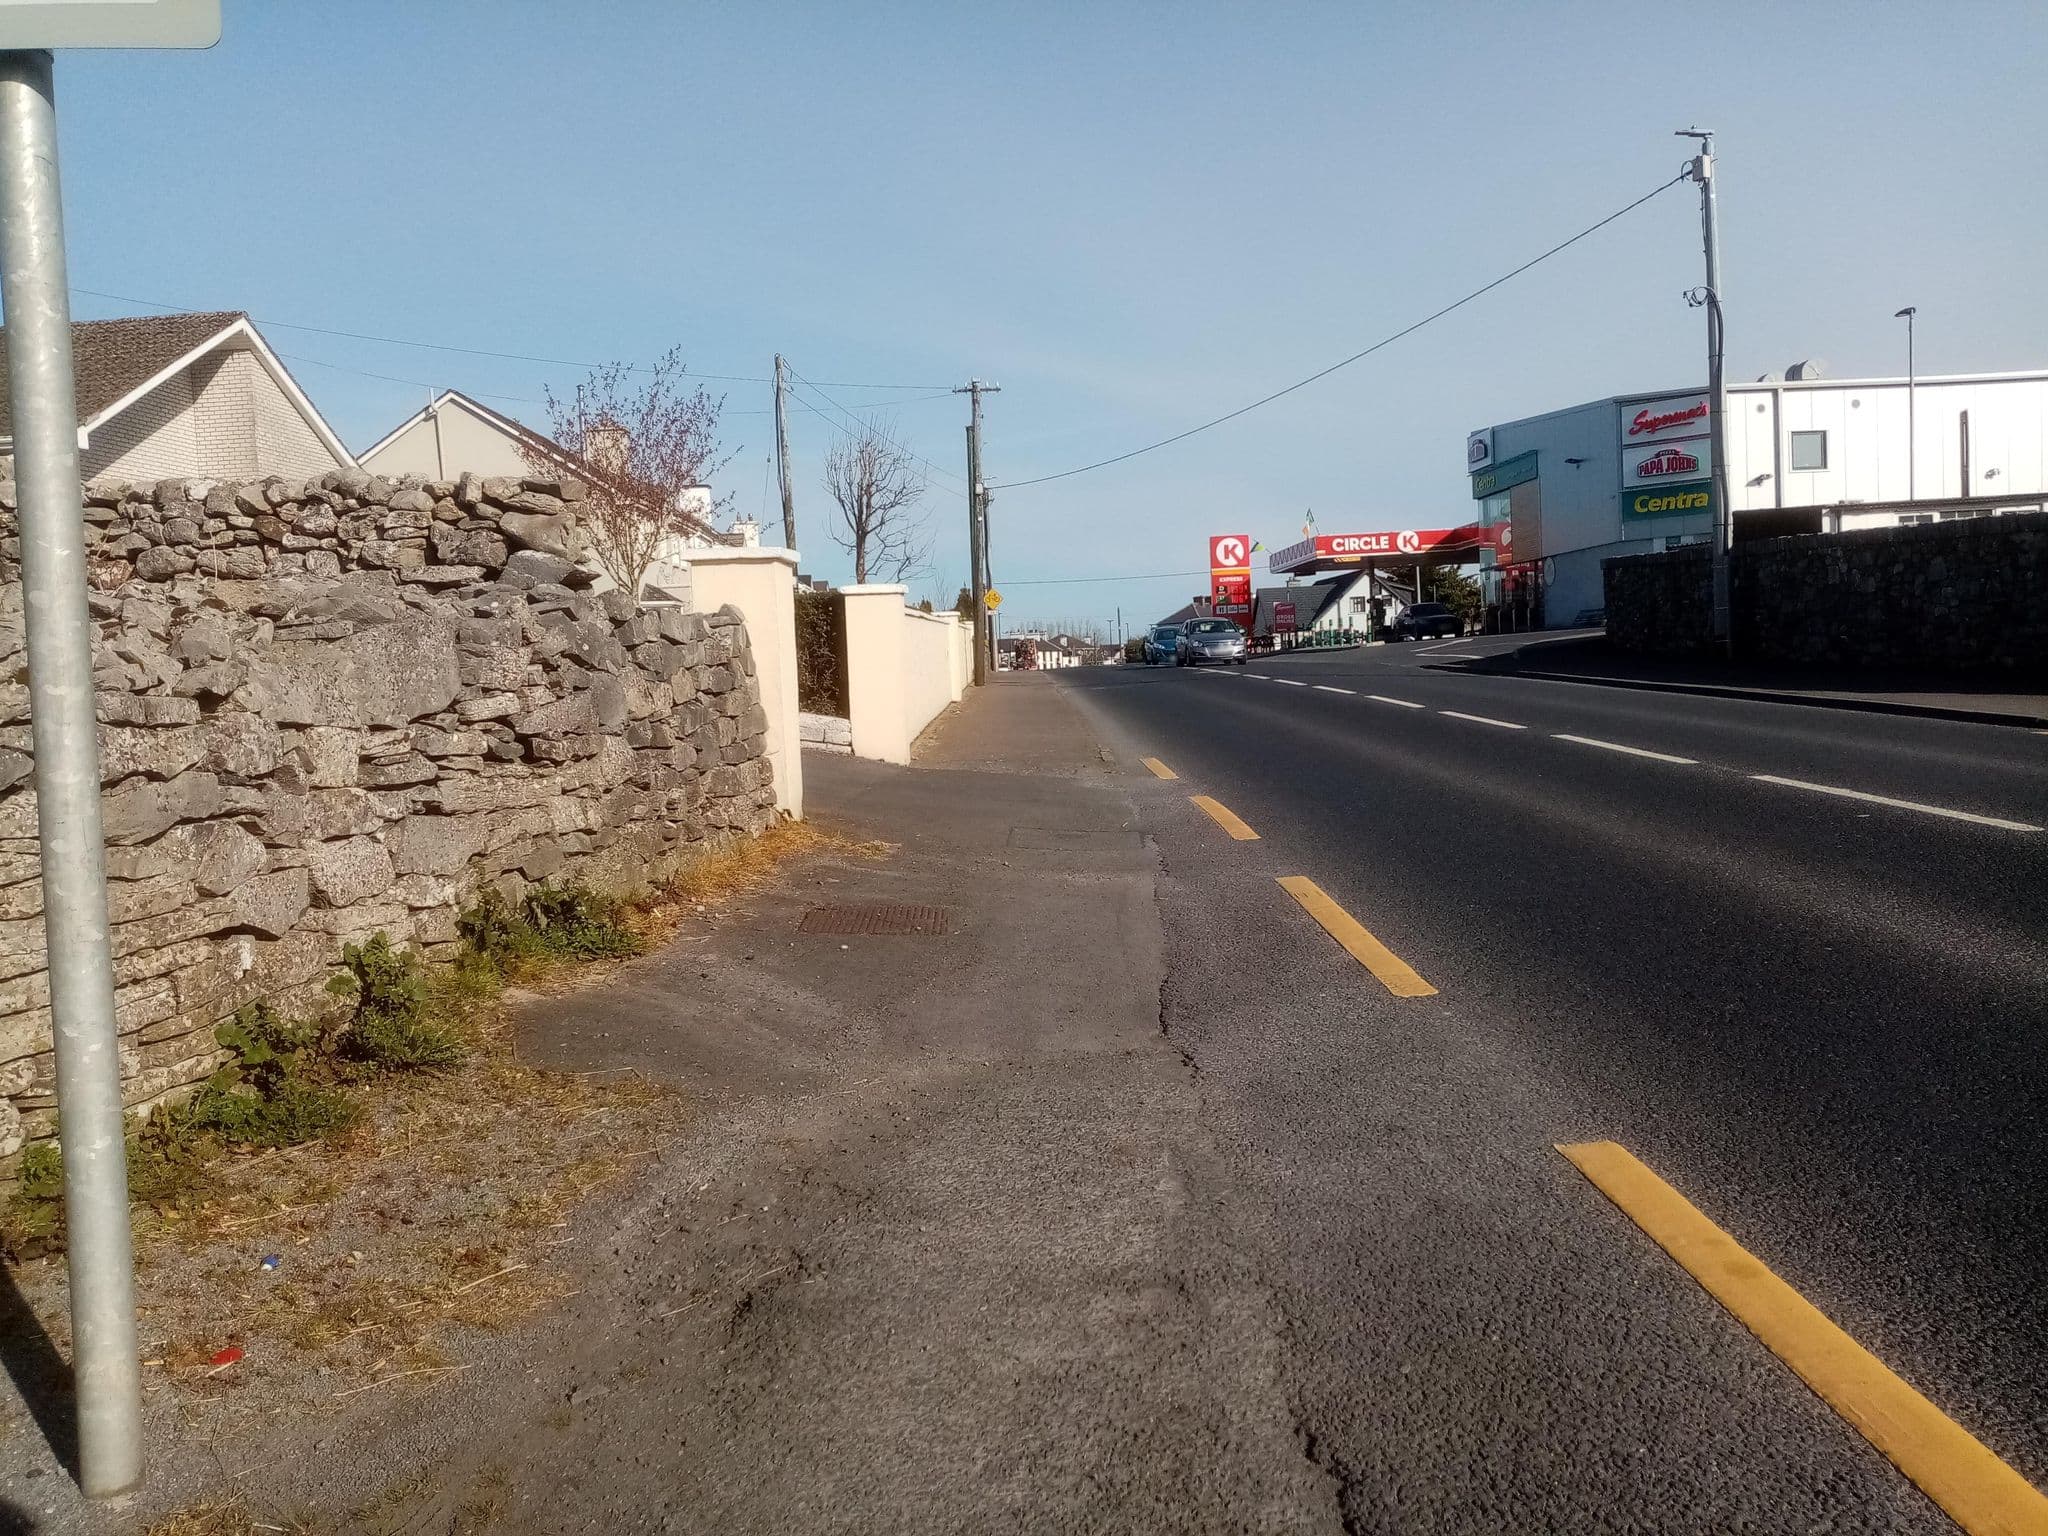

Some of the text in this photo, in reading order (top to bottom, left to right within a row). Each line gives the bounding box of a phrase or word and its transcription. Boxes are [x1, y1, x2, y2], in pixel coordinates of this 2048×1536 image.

[1639, 458, 1664, 475] PAPA
[1634, 492, 1709, 513] Centra
[1331, 533, 1418, 552] CIRCLE K
[1222, 542, 1243, 564] K
